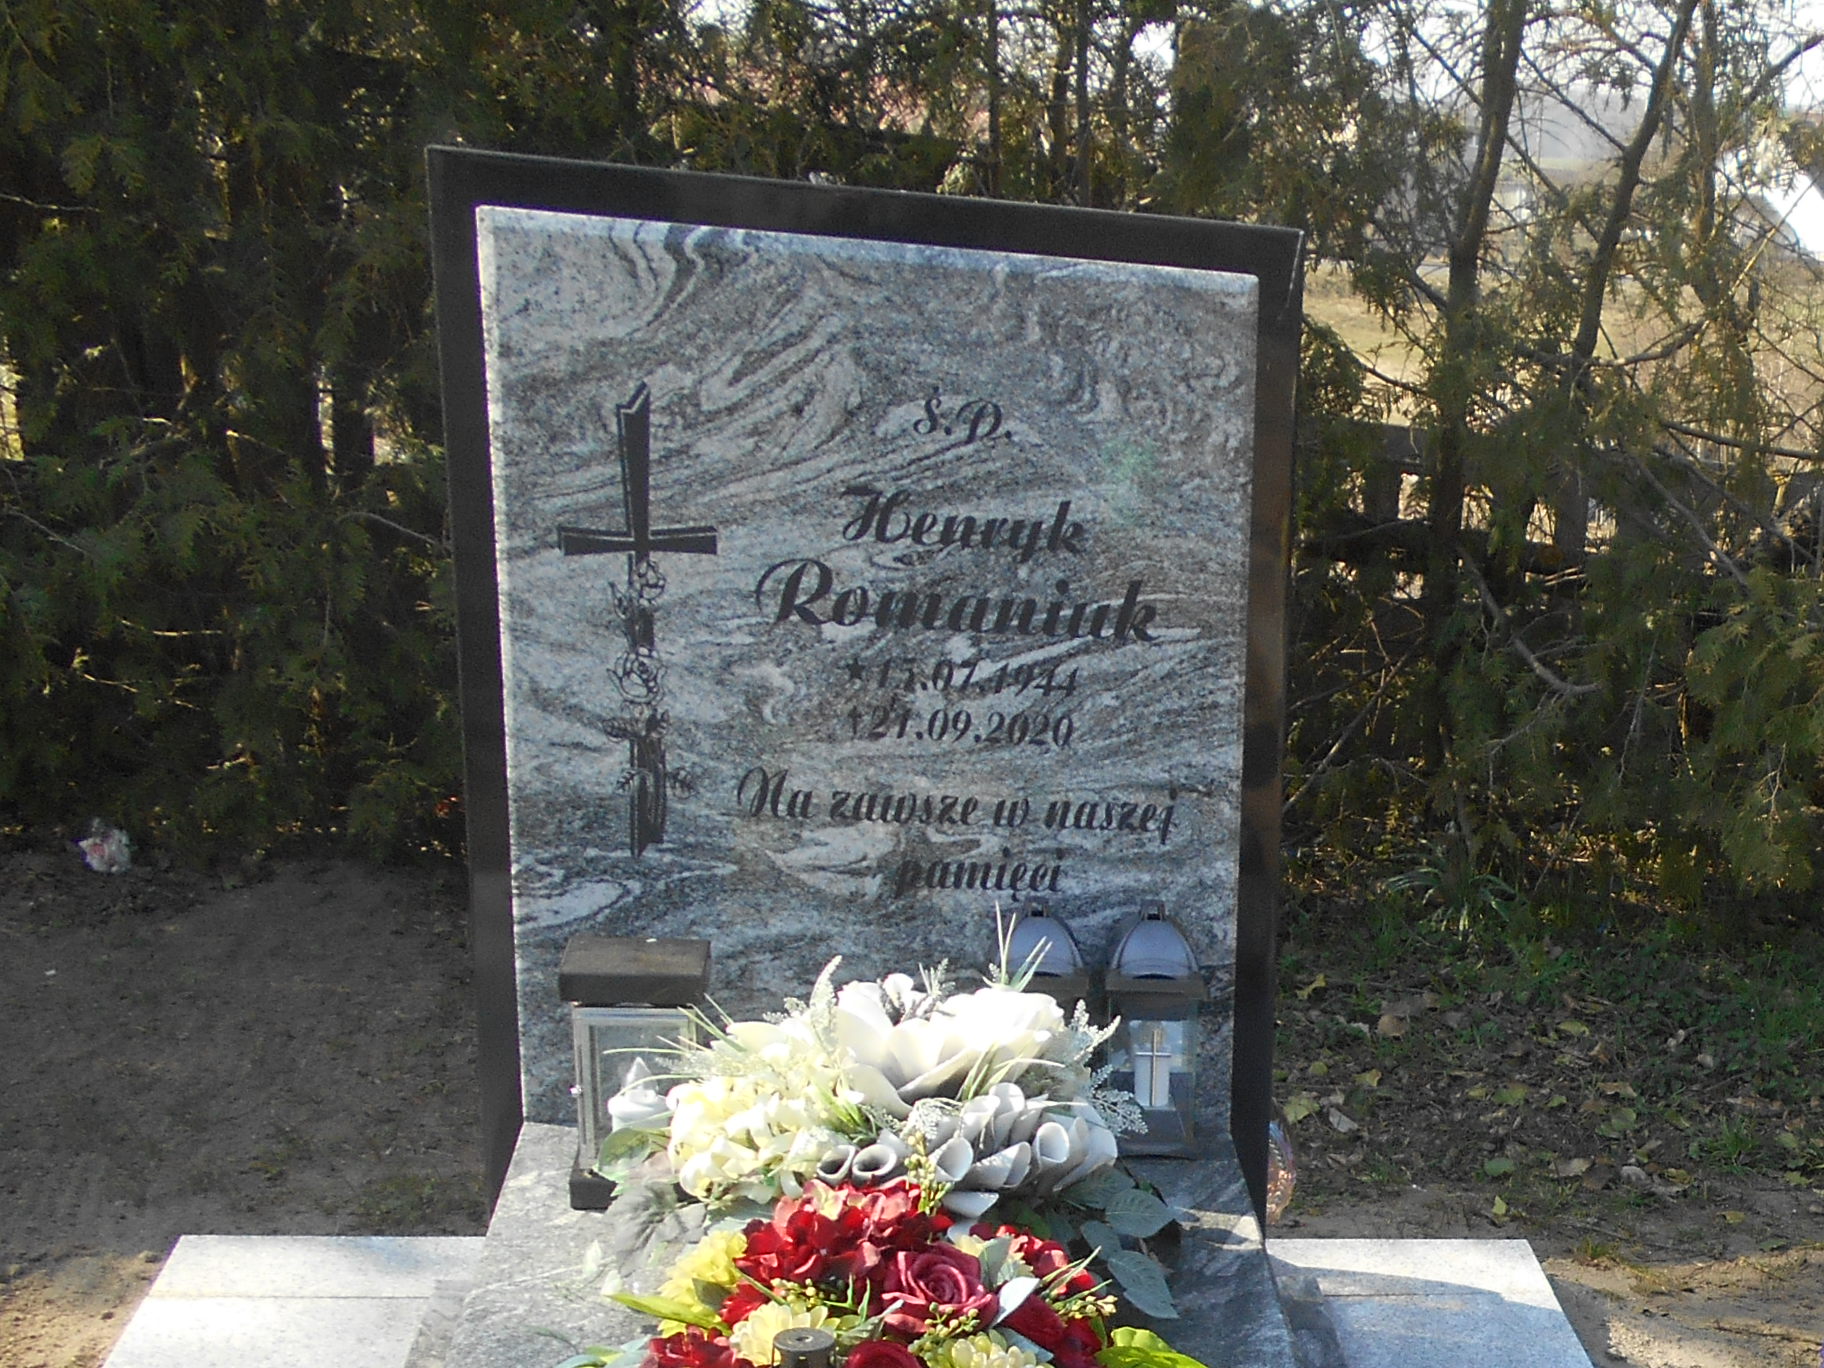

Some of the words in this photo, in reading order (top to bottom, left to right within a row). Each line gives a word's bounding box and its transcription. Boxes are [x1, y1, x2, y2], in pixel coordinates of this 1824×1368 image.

[840, 483, 1085, 564] Henryk
[754, 558, 1162, 643] Romaniuk
[737, 766, 814, 819] Na
[829, 789, 981, 826] zawsze
[993, 797, 1030, 828] w
[1044, 781, 1177, 844] naszej
[899, 847, 1064, 902] pamięci
